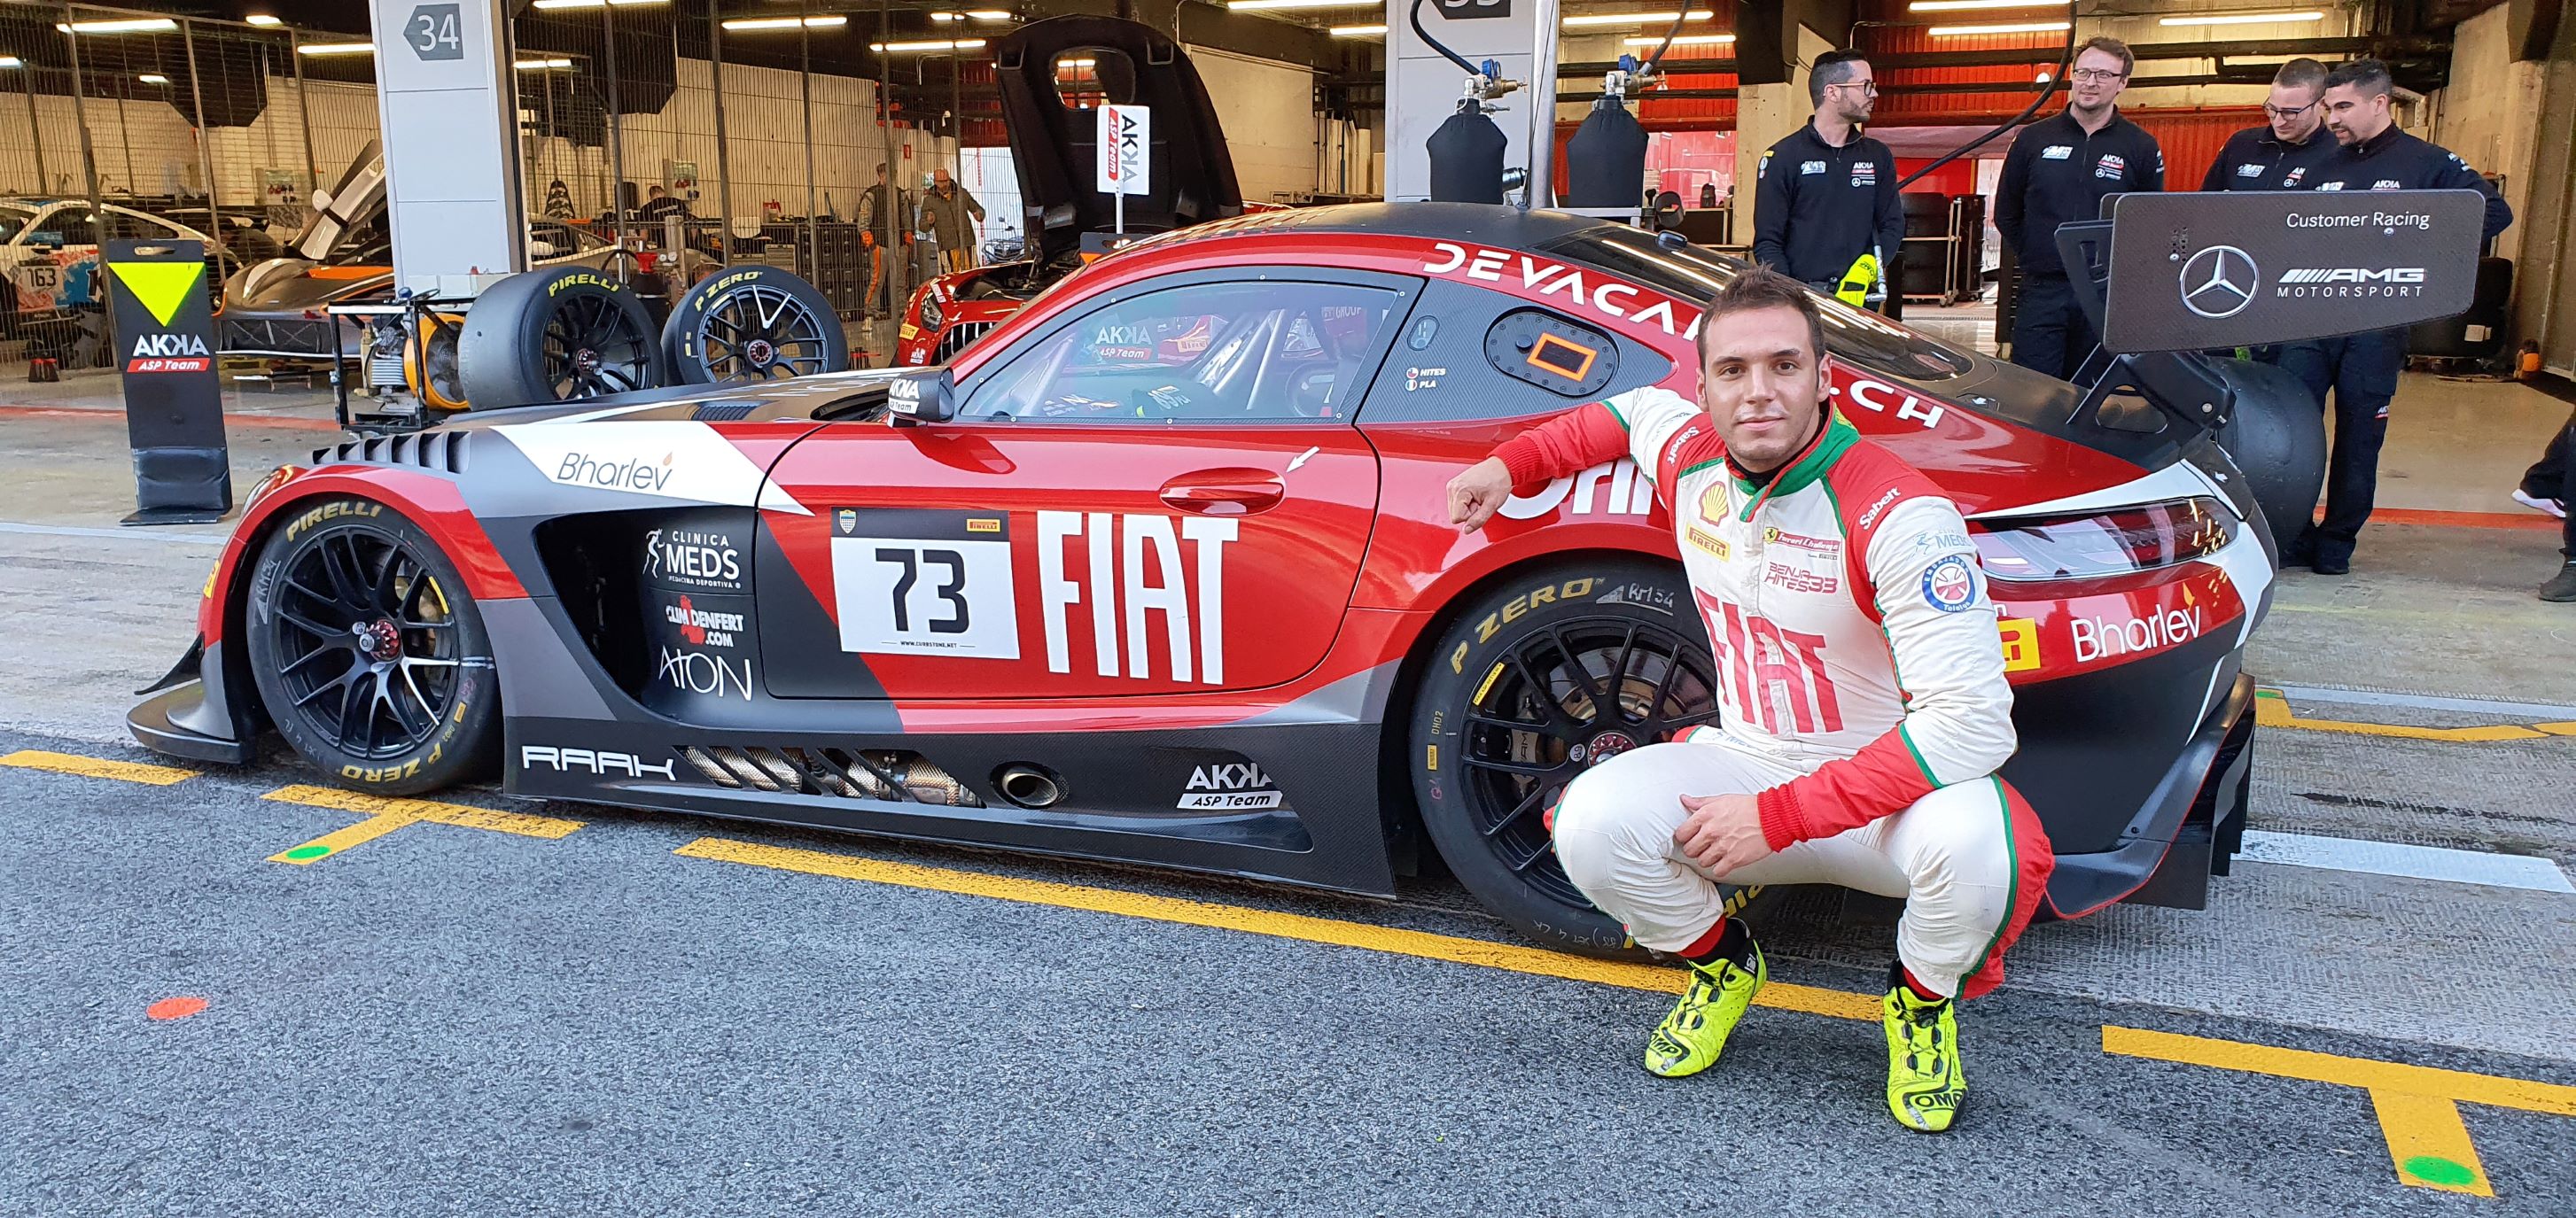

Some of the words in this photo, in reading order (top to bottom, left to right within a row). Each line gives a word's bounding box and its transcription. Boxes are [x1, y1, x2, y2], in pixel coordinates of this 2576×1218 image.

[417, 14, 459, 51] 34
[1109, 117, 1117, 139] ASP
[1109, 141, 1117, 173] Team
[1121, 113, 1138, 182] AKKA
[2286, 213, 2369, 228] Customer
[2372, 210, 2430, 230] Racing
[27, 268, 57, 286] 163
[549, 274, 619, 298] PIRELLI
[2323, 268, 2424, 283] AMG
[694, 296, 705, 312] P
[705, 271, 759, 299] ZERO
[2276, 285, 2423, 298] MOTORSPORT
[132, 334, 210, 357] AKKA
[1095, 325, 1153, 345] AKKA
[138, 361, 162, 371] ASP
[164, 360, 201, 371] Team
[1117, 348, 1145, 359] Team
[1420, 368, 1446, 376] HITES
[895, 402, 912, 412] Team
[1668, 426, 1700, 467] Sabelt
[556, 453, 673, 492] Bharlev
[1859, 486, 1902, 531] Sabelt
[286, 501, 383, 542] PIRELLI
[672, 530, 729, 547] CLINICA
[1688, 526, 1727, 557] PIRELLI
[665, 543, 740, 580] MEDS
[696, 578, 734, 588] DEPORTIVA
[876, 547, 970, 634] 73
[1037, 509, 1239, 685] FIAT
[690, 609, 743, 632] DENFERT
[1451, 640, 1469, 675] P
[1475, 578, 1593, 644] ZERO
[705, 631, 734, 648] .COM
[2070, 603, 2200, 663] Bharlev
[1695, 586, 1844, 735] FIAT
[427, 742, 443, 765] P
[521, 745, 676, 781] RAAK
[341, 757, 421, 783] ZERO
[1192, 795, 1222, 807] ASP
[1226, 794, 1272, 807] Team
